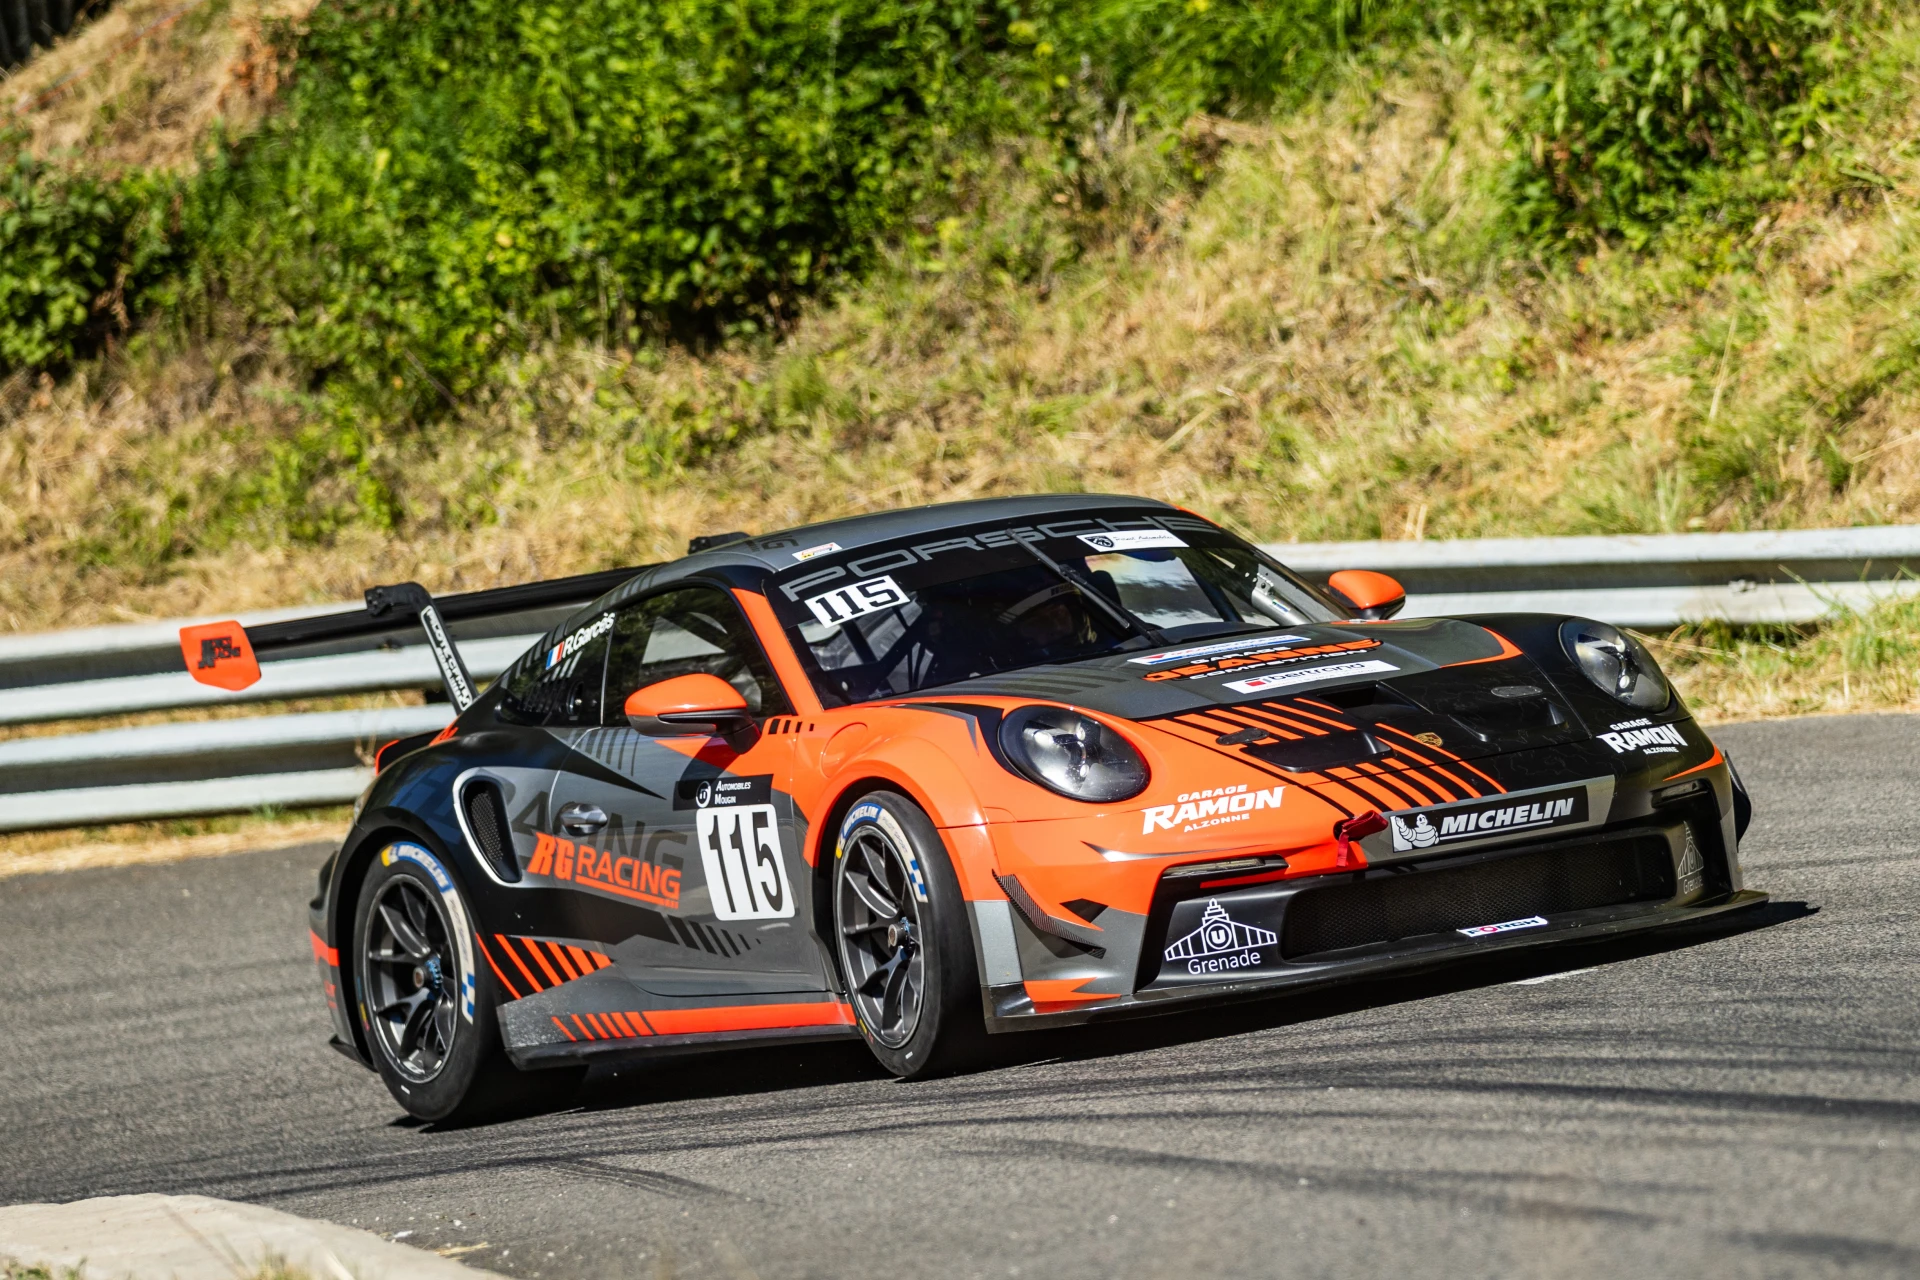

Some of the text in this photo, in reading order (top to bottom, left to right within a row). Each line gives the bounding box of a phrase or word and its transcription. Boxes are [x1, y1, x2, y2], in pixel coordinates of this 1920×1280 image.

[778, 515, 1221, 602] PORSCHE
[815, 578, 901, 622] 115
[1596, 723, 1688, 754] RAMON
[1609, 717, 1652, 731] GARAGE
[1643, 746, 1679, 755] ALZONNE
[1140, 786, 1286, 835] RAMON
[1177, 784, 1248, 803] GARAGE
[1184, 813, 1250, 833] ALZONNE
[1440, 797, 1574, 835] MICHELIN
[527, 832, 682, 900] RG RACING
[708, 811, 783, 913] 115
[1187, 948, 1261, 975] Grenade
